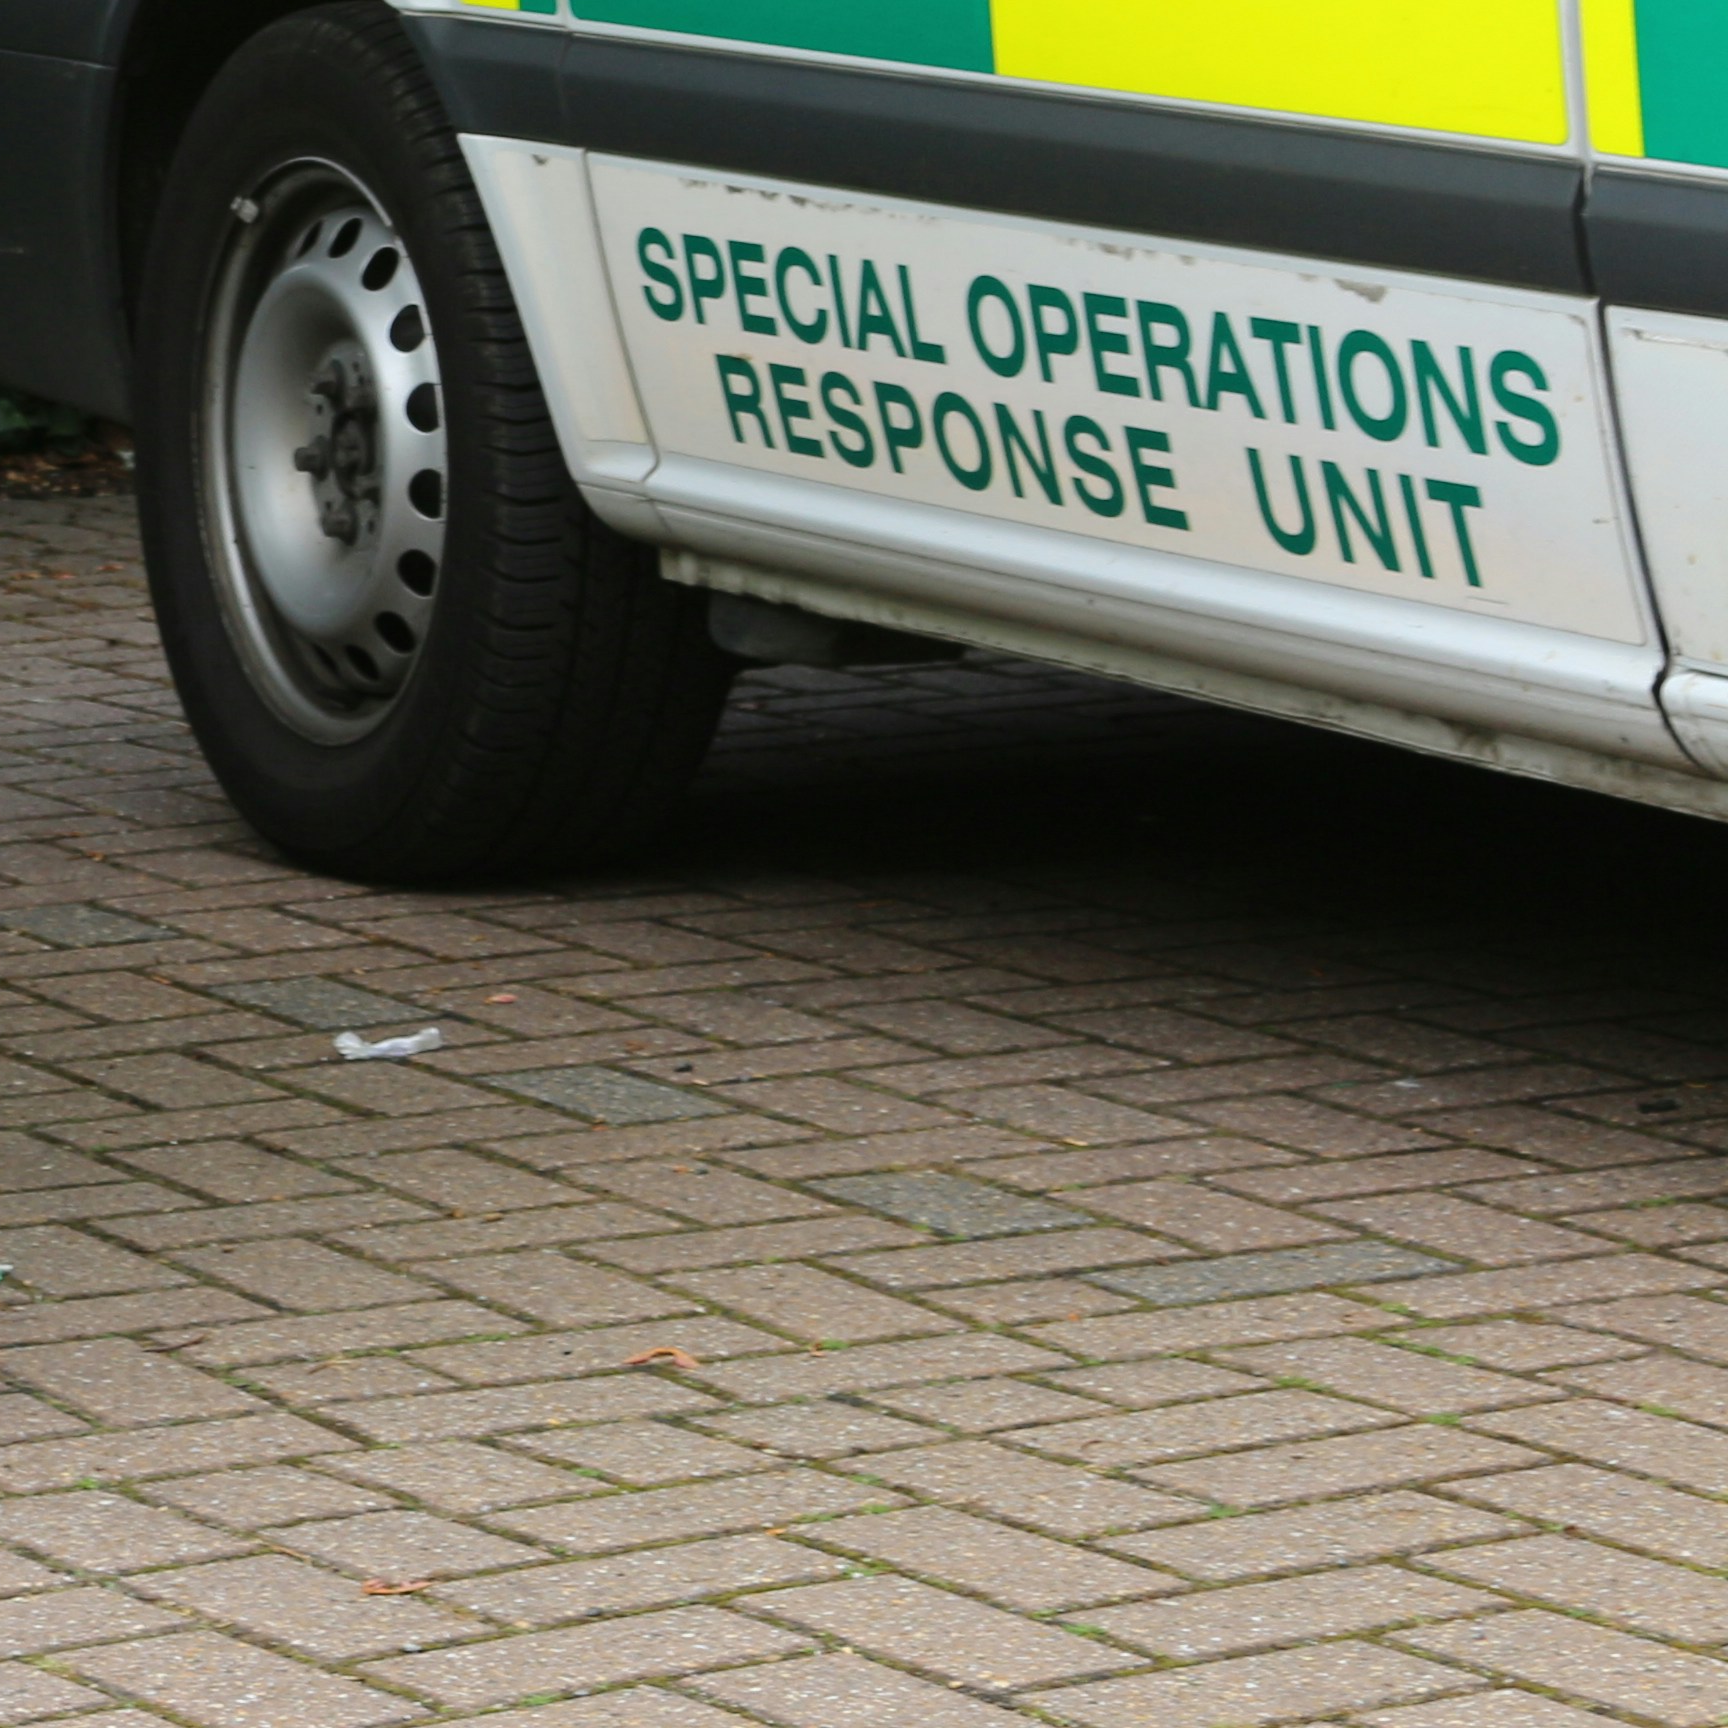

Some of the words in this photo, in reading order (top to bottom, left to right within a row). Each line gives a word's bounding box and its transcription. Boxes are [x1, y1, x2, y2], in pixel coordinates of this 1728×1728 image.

[637, 227, 946, 365] SPECIAL
[967, 275, 1562, 468] OPERATIONS
[717, 354, 1190, 532] RESPONSE
[1246, 446, 1485, 589] UNIT
